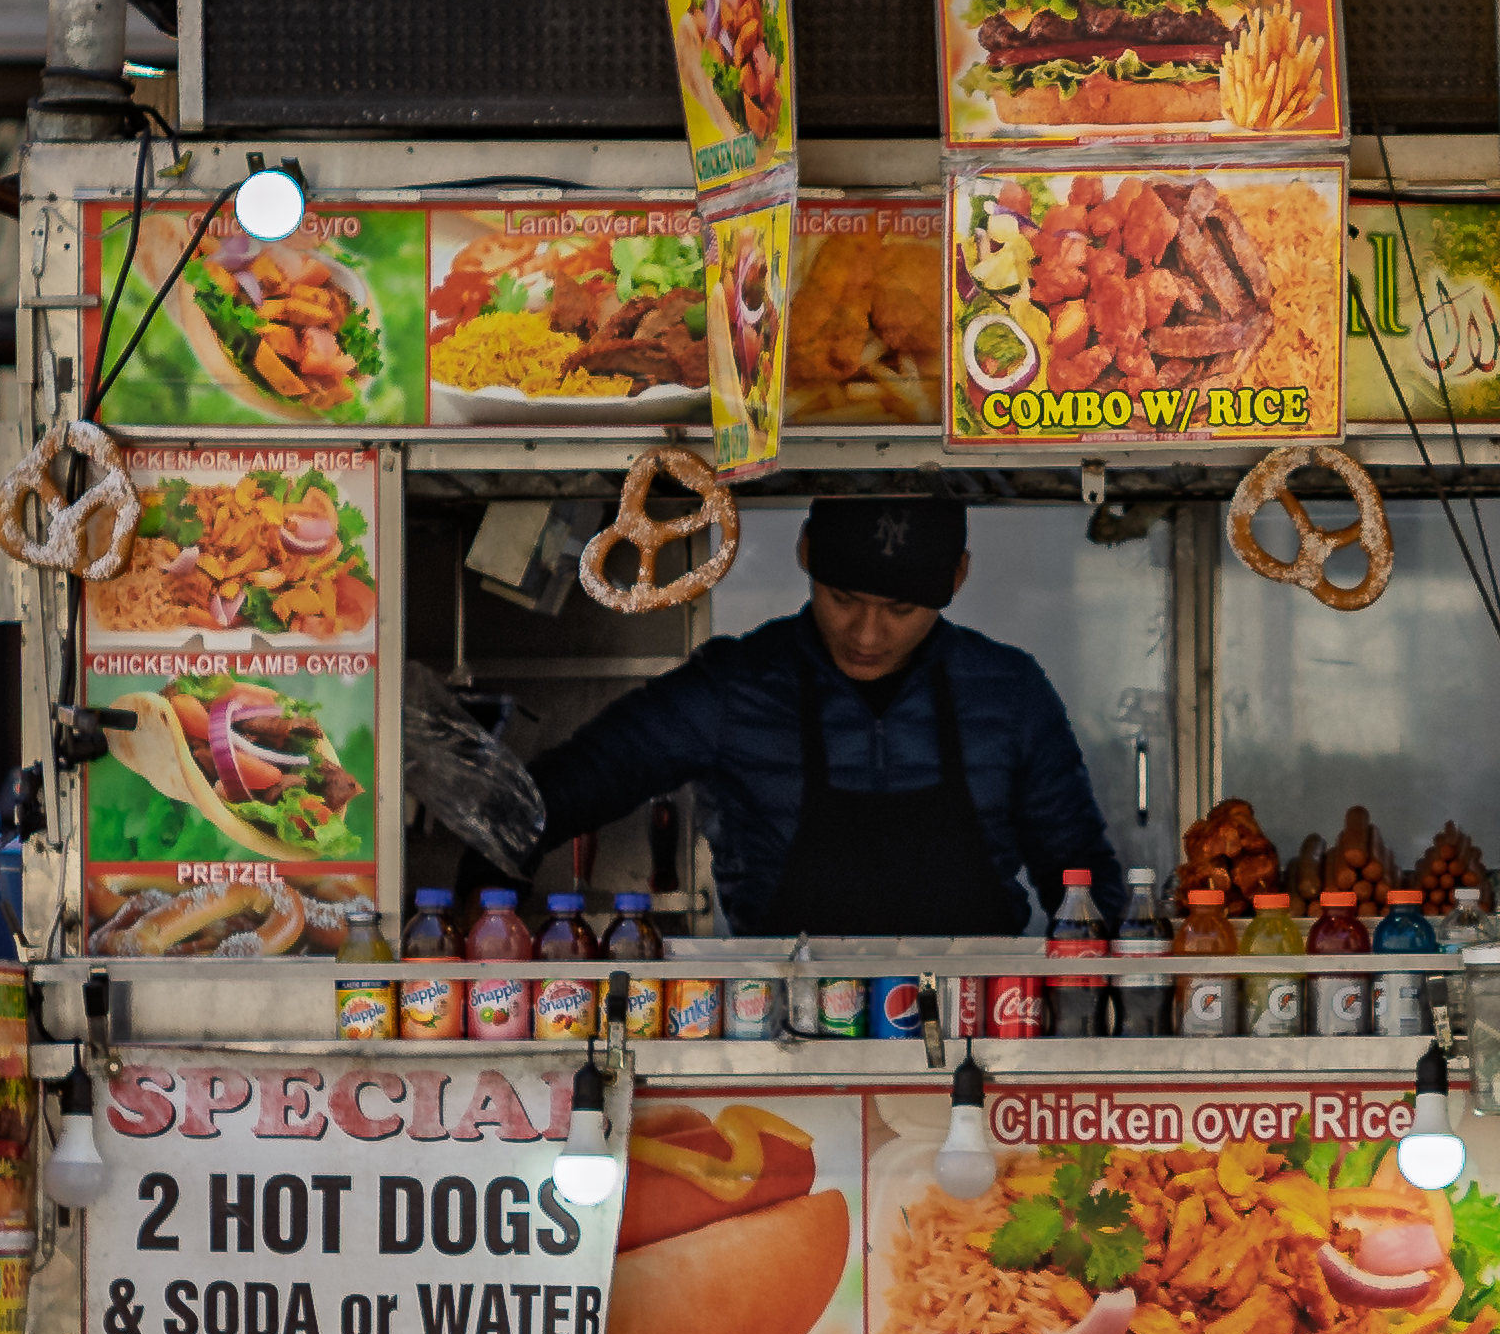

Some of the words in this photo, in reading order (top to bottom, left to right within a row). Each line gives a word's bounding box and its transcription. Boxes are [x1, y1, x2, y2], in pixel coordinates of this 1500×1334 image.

[300, 212, 361, 239] Gyro
[505, 211, 578, 236] Lamb
[582, 217, 640, 235] over
[646, 211, 700, 235] Rice
[983, 389, 1132, 428] COMBO
[1141, 389, 1198, 433] W/
[1207, 386, 1310, 427] RICE
[199, 451, 232, 471] OR
[238, 451, 299, 471] LAMB
[313, 451, 365, 471] RICE
[93, 653, 189, 676] CHICKEN
[195, 653, 229, 676] OR
[236, 654, 299, 676] LAMB
[306, 653, 370, 676] GYRO
[176, 862, 285, 885] PRETZEL
[339, 1003, 387, 1028] Snapple
[538, 988, 592, 1017] Snapple
[668, 985, 722, 1036] Sunkist
[990, 1095, 1182, 1144] Chicken
[1193, 1104, 1299, 1144] over
[1311, 1094, 1413, 1141] Rice
[136, 1171, 180, 1252] 2
[207, 1172, 353, 1255] HOT
[377, 1173, 582, 1257] DOGS
